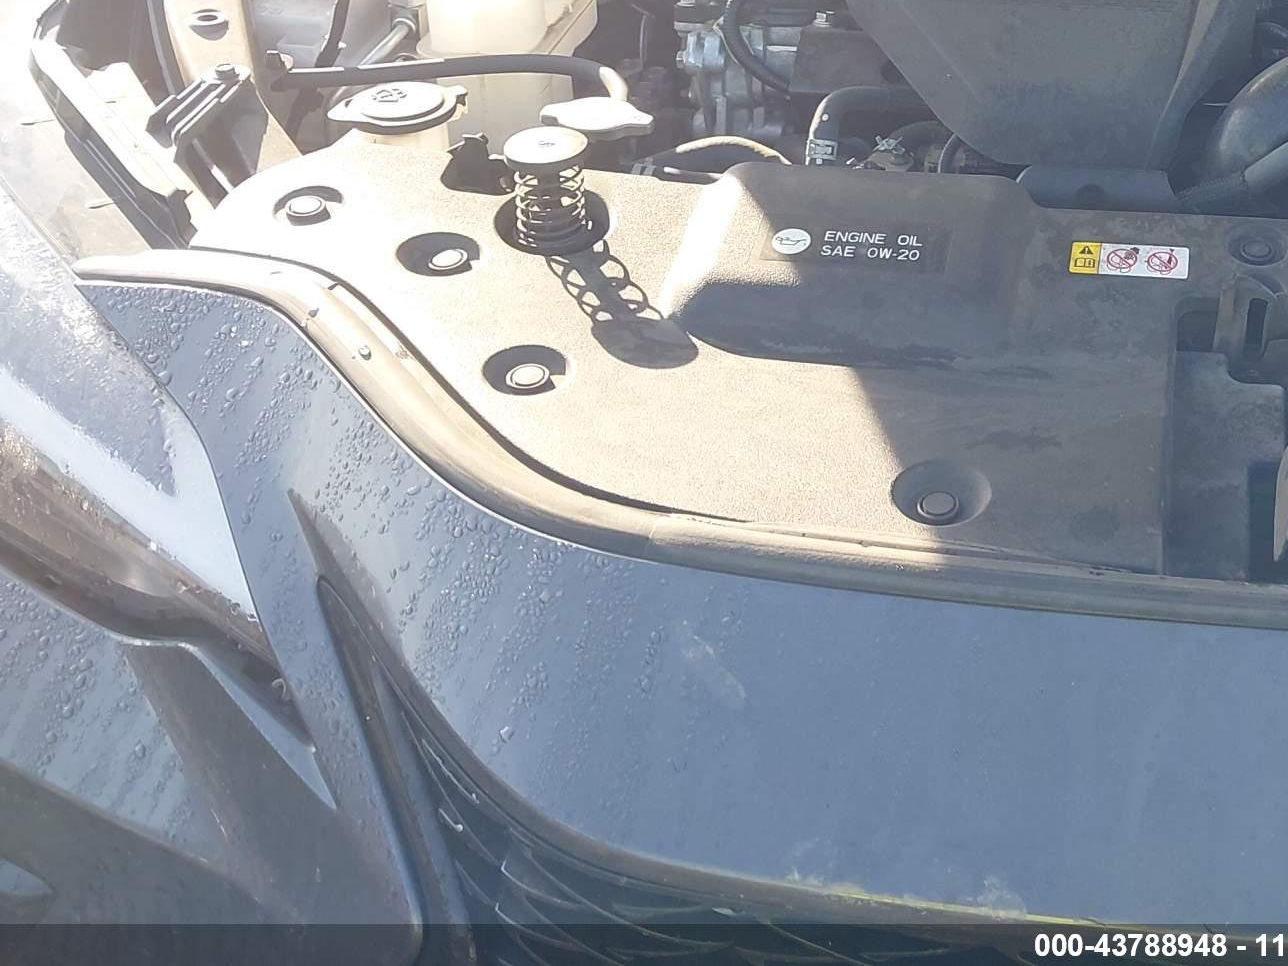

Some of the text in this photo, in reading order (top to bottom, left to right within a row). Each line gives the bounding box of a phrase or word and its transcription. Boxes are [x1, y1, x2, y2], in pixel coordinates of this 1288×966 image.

[823, 230, 923, 247] ENGINE OIL
[820, 245, 920, 261] SAE 0W-20
